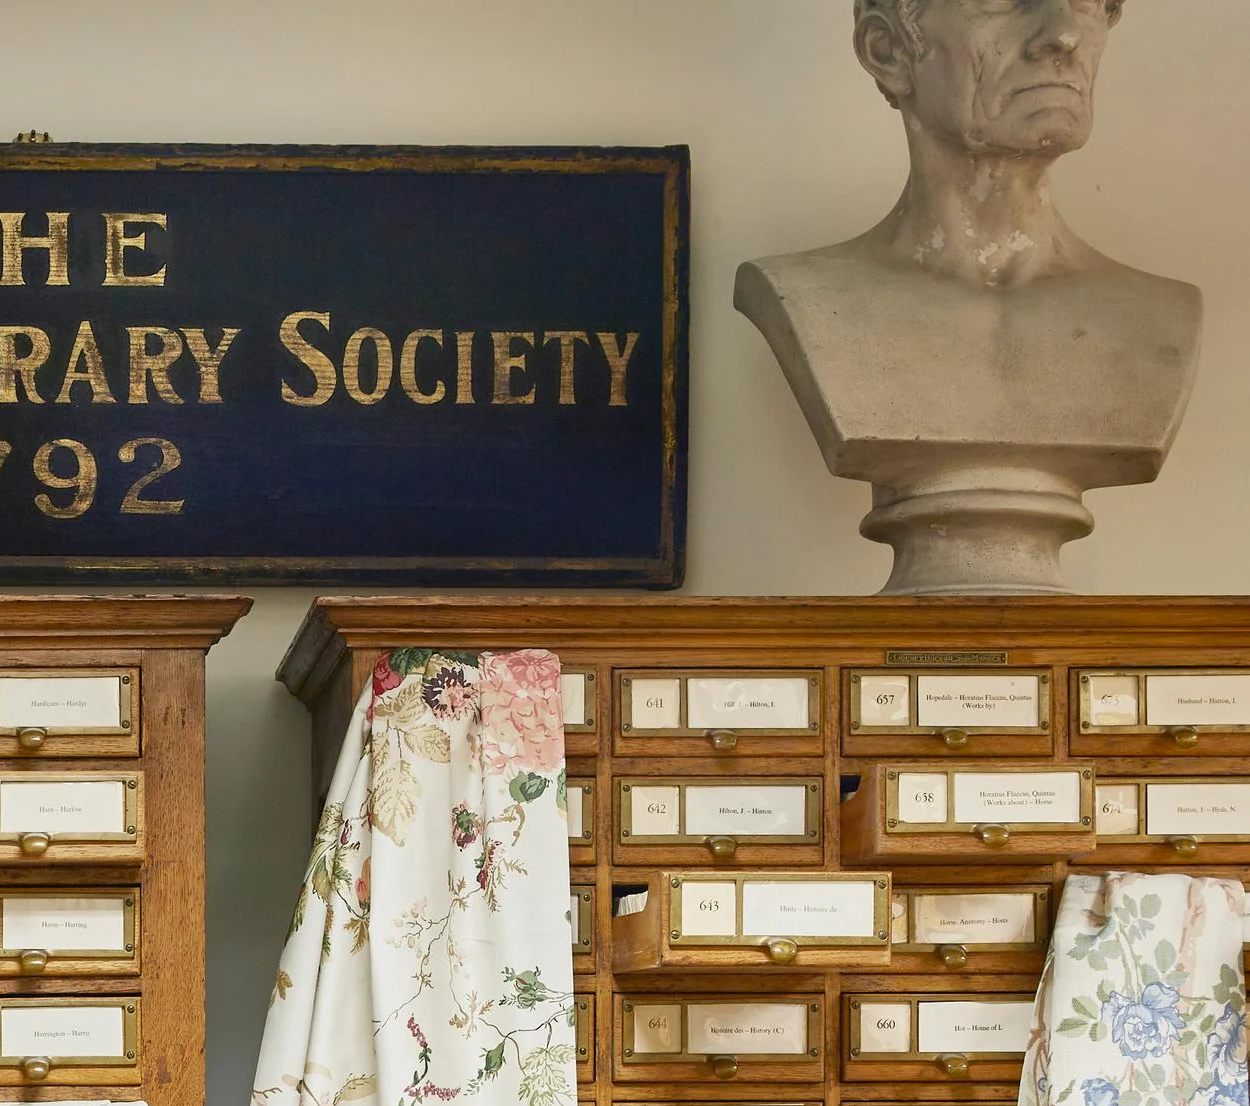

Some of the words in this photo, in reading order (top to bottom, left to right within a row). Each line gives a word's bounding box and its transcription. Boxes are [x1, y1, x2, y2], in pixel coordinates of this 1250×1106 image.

[280, 311, 637, 405] SOCIETY
[646, 697, 663, 709] 641
[876, 694, 895, 705] 657
[926, 693, 953, 703] Hopedale
[1008, 694, 1033, 702] Quintus
[984, 702, 996, 711] by)
[647, 802, 666, 814] 642
[699, 900, 720, 911] 643
[876, 1018, 896, 1030] 660
